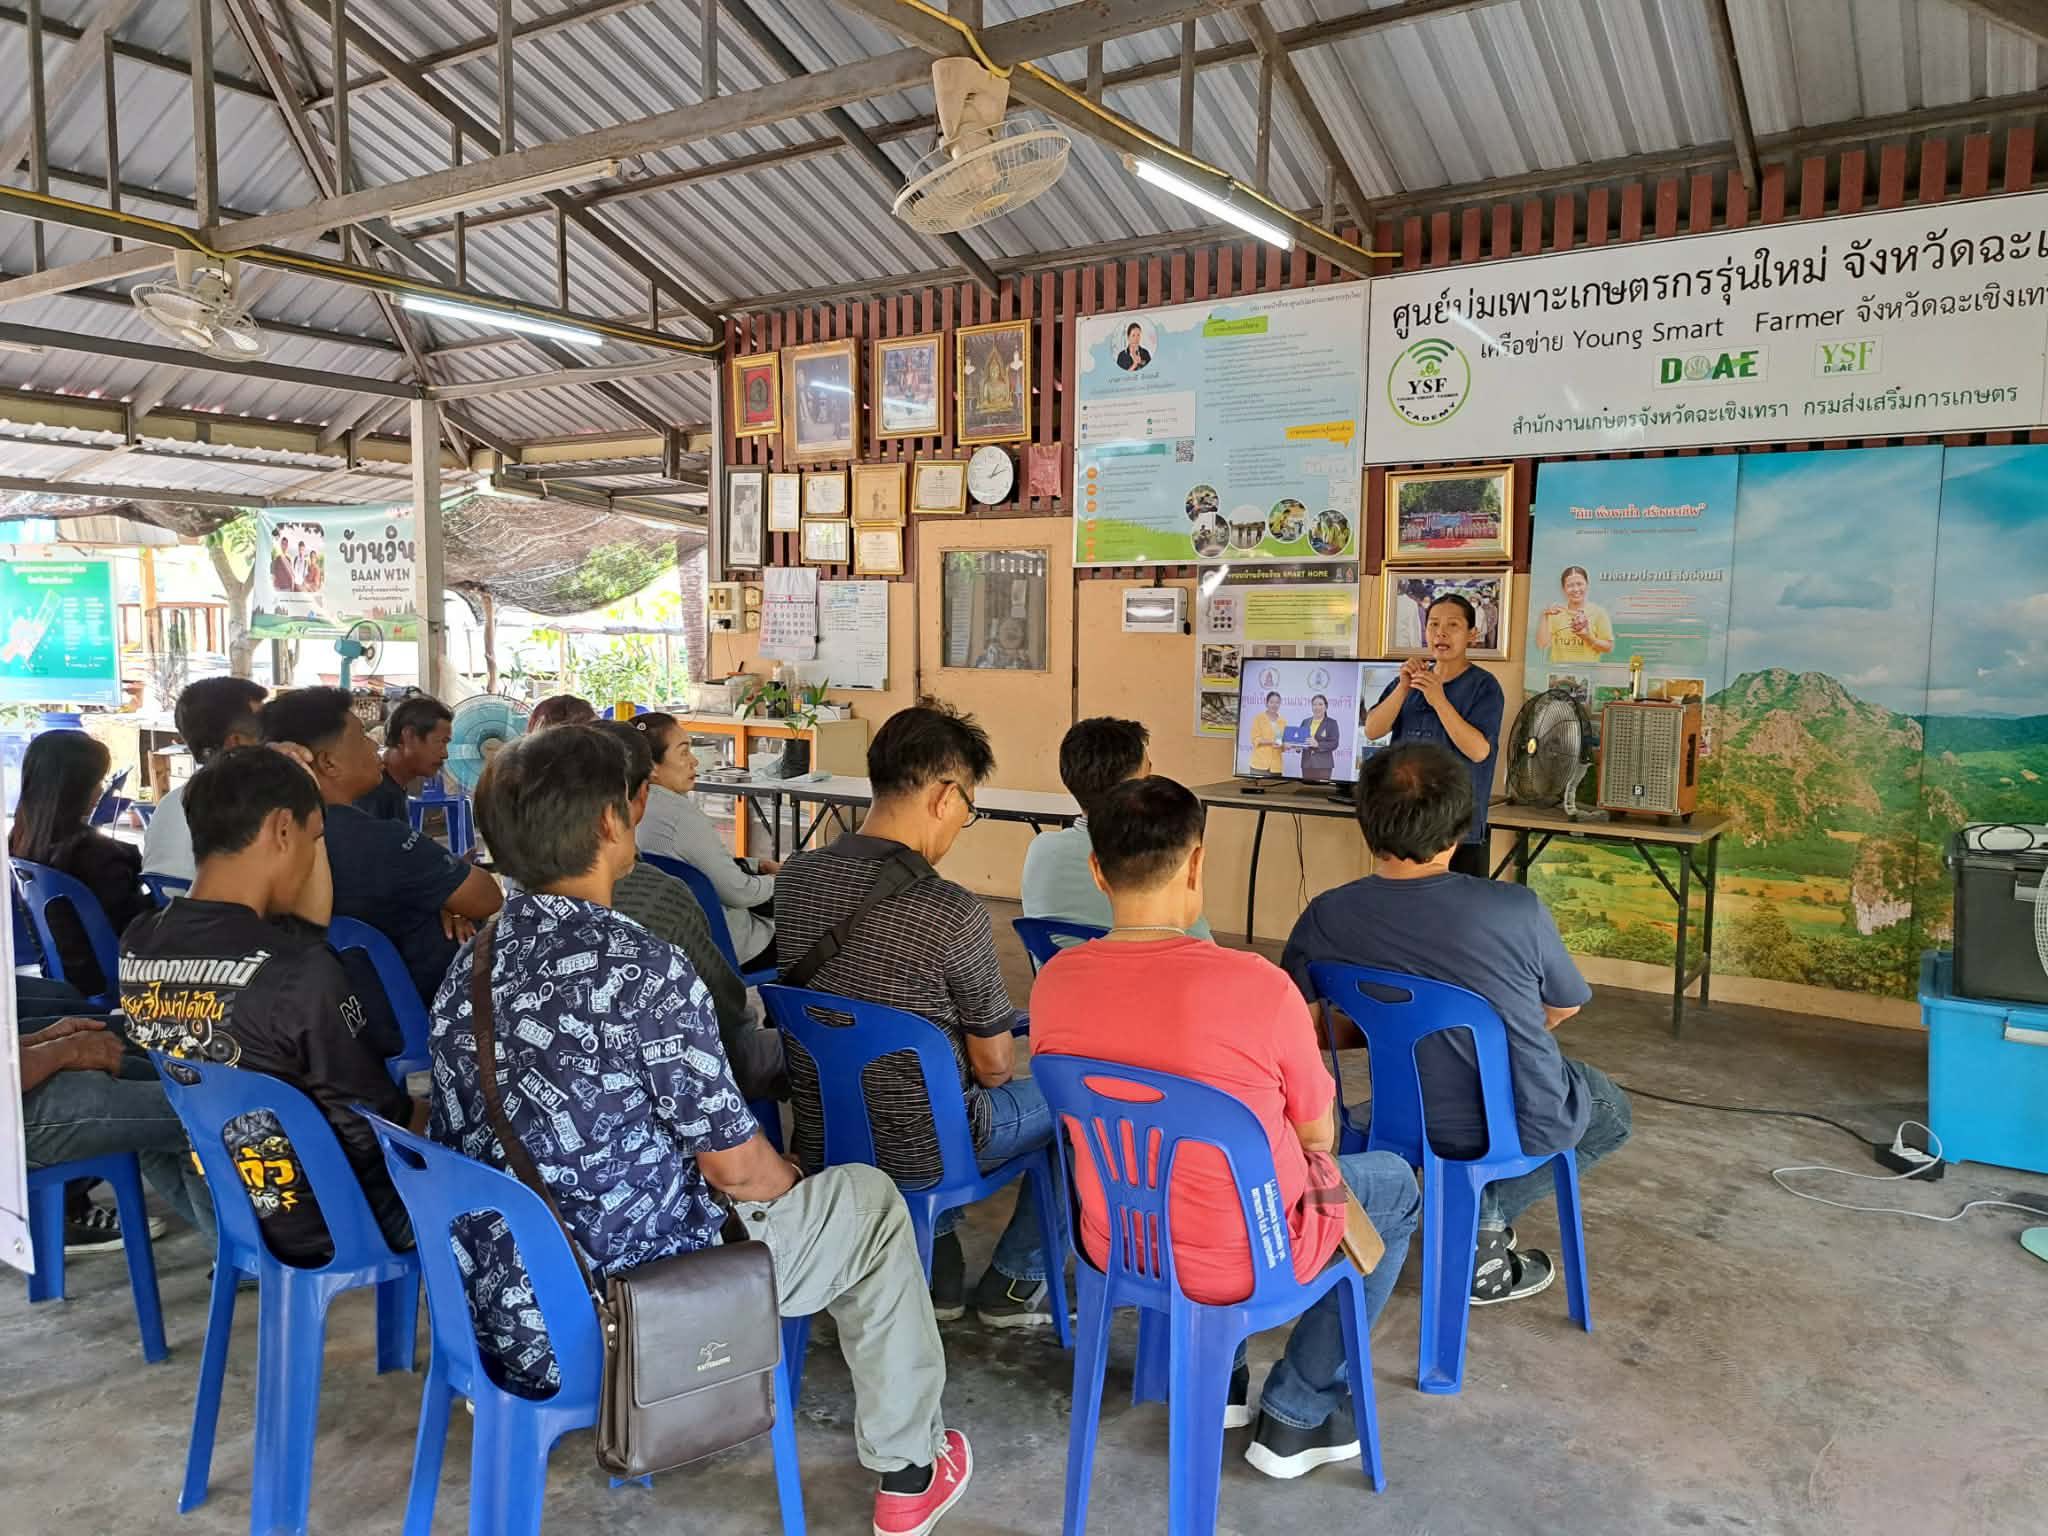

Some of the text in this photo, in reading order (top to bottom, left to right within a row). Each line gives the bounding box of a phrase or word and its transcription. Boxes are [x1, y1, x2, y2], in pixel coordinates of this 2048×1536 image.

[1573, 329, 1643, 350] Young
[1652, 318, 1724, 342] Smart
[1756, 309, 1845, 332] Farmer
[1857, 282, 2048, 322] จังหวัดฉะเชิงเท
[1822, 341, 1875, 371] YSF
[1408, 377, 1448, 395] YSF
[1804, 386, 2018, 415] กรมส่งเสริมการเกษตร
[1399, 401, 1455, 422] ACADEMY
[351, 568, 410, 581] BAAN WIN
[1307, 570, 1329, 578] HOME
